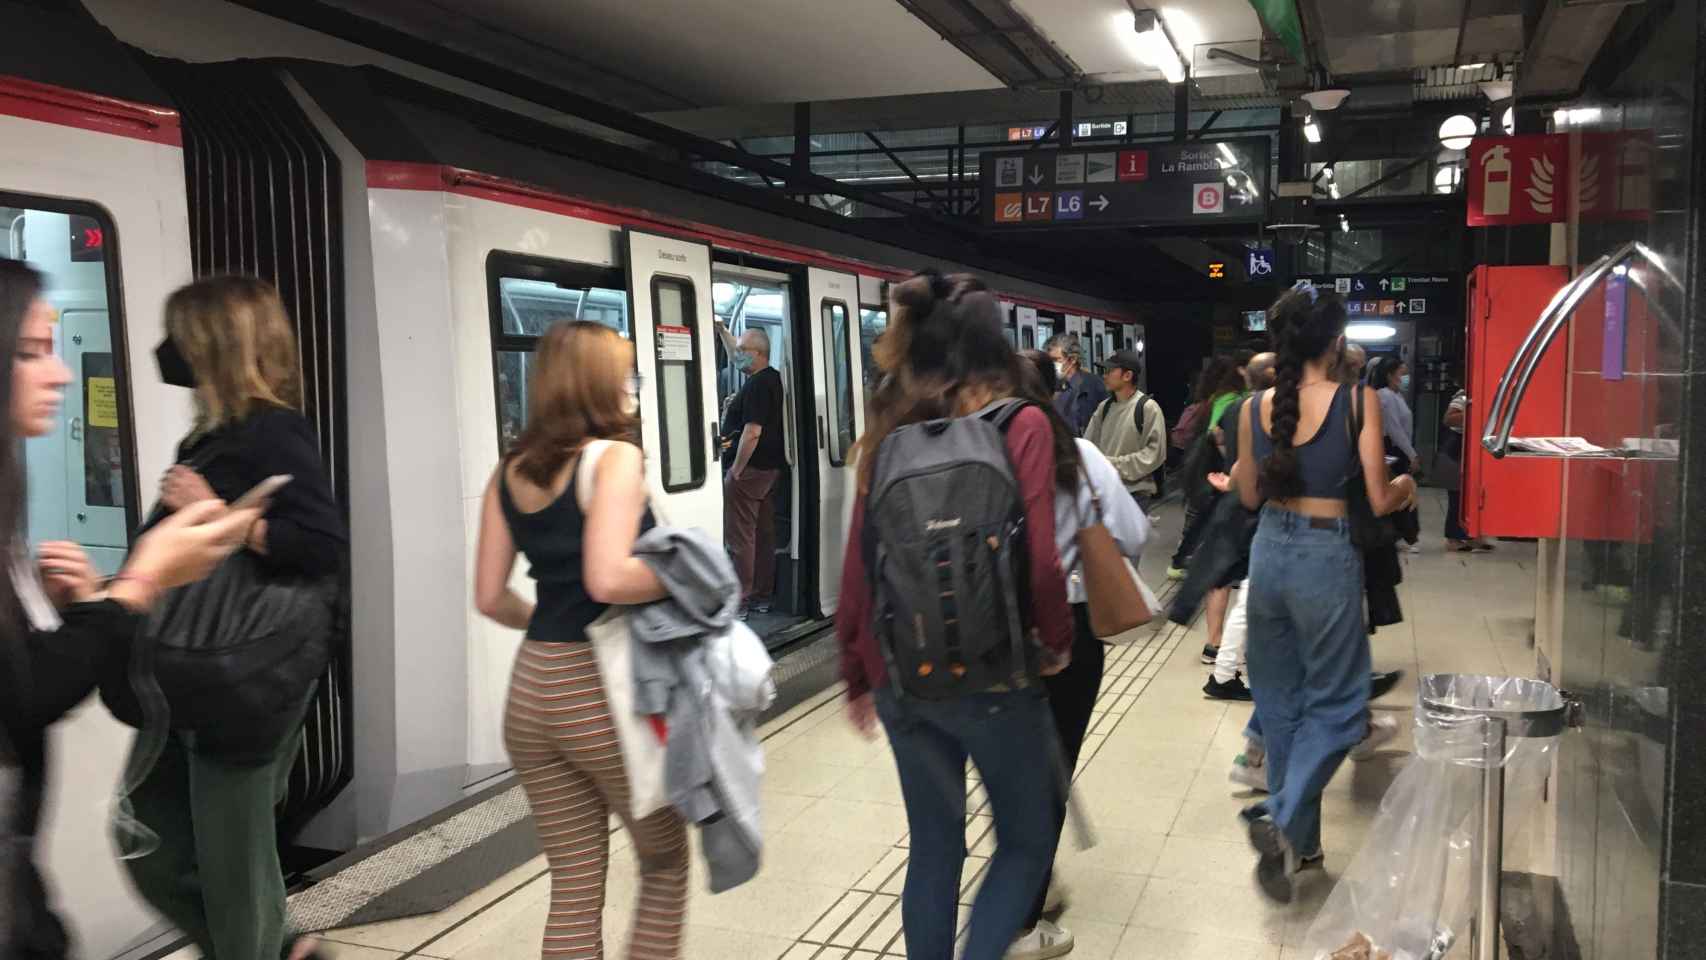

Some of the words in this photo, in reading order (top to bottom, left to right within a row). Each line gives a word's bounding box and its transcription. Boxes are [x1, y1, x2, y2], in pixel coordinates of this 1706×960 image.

[1022, 128, 1033, 137] L7
[1161, 163, 1175, 172] La
[1027, 197, 1050, 214] L7
[1057, 196, 1081, 212] L6
[1348, 303, 1361, 312] L6
[1363, 303, 1377, 312] L7
